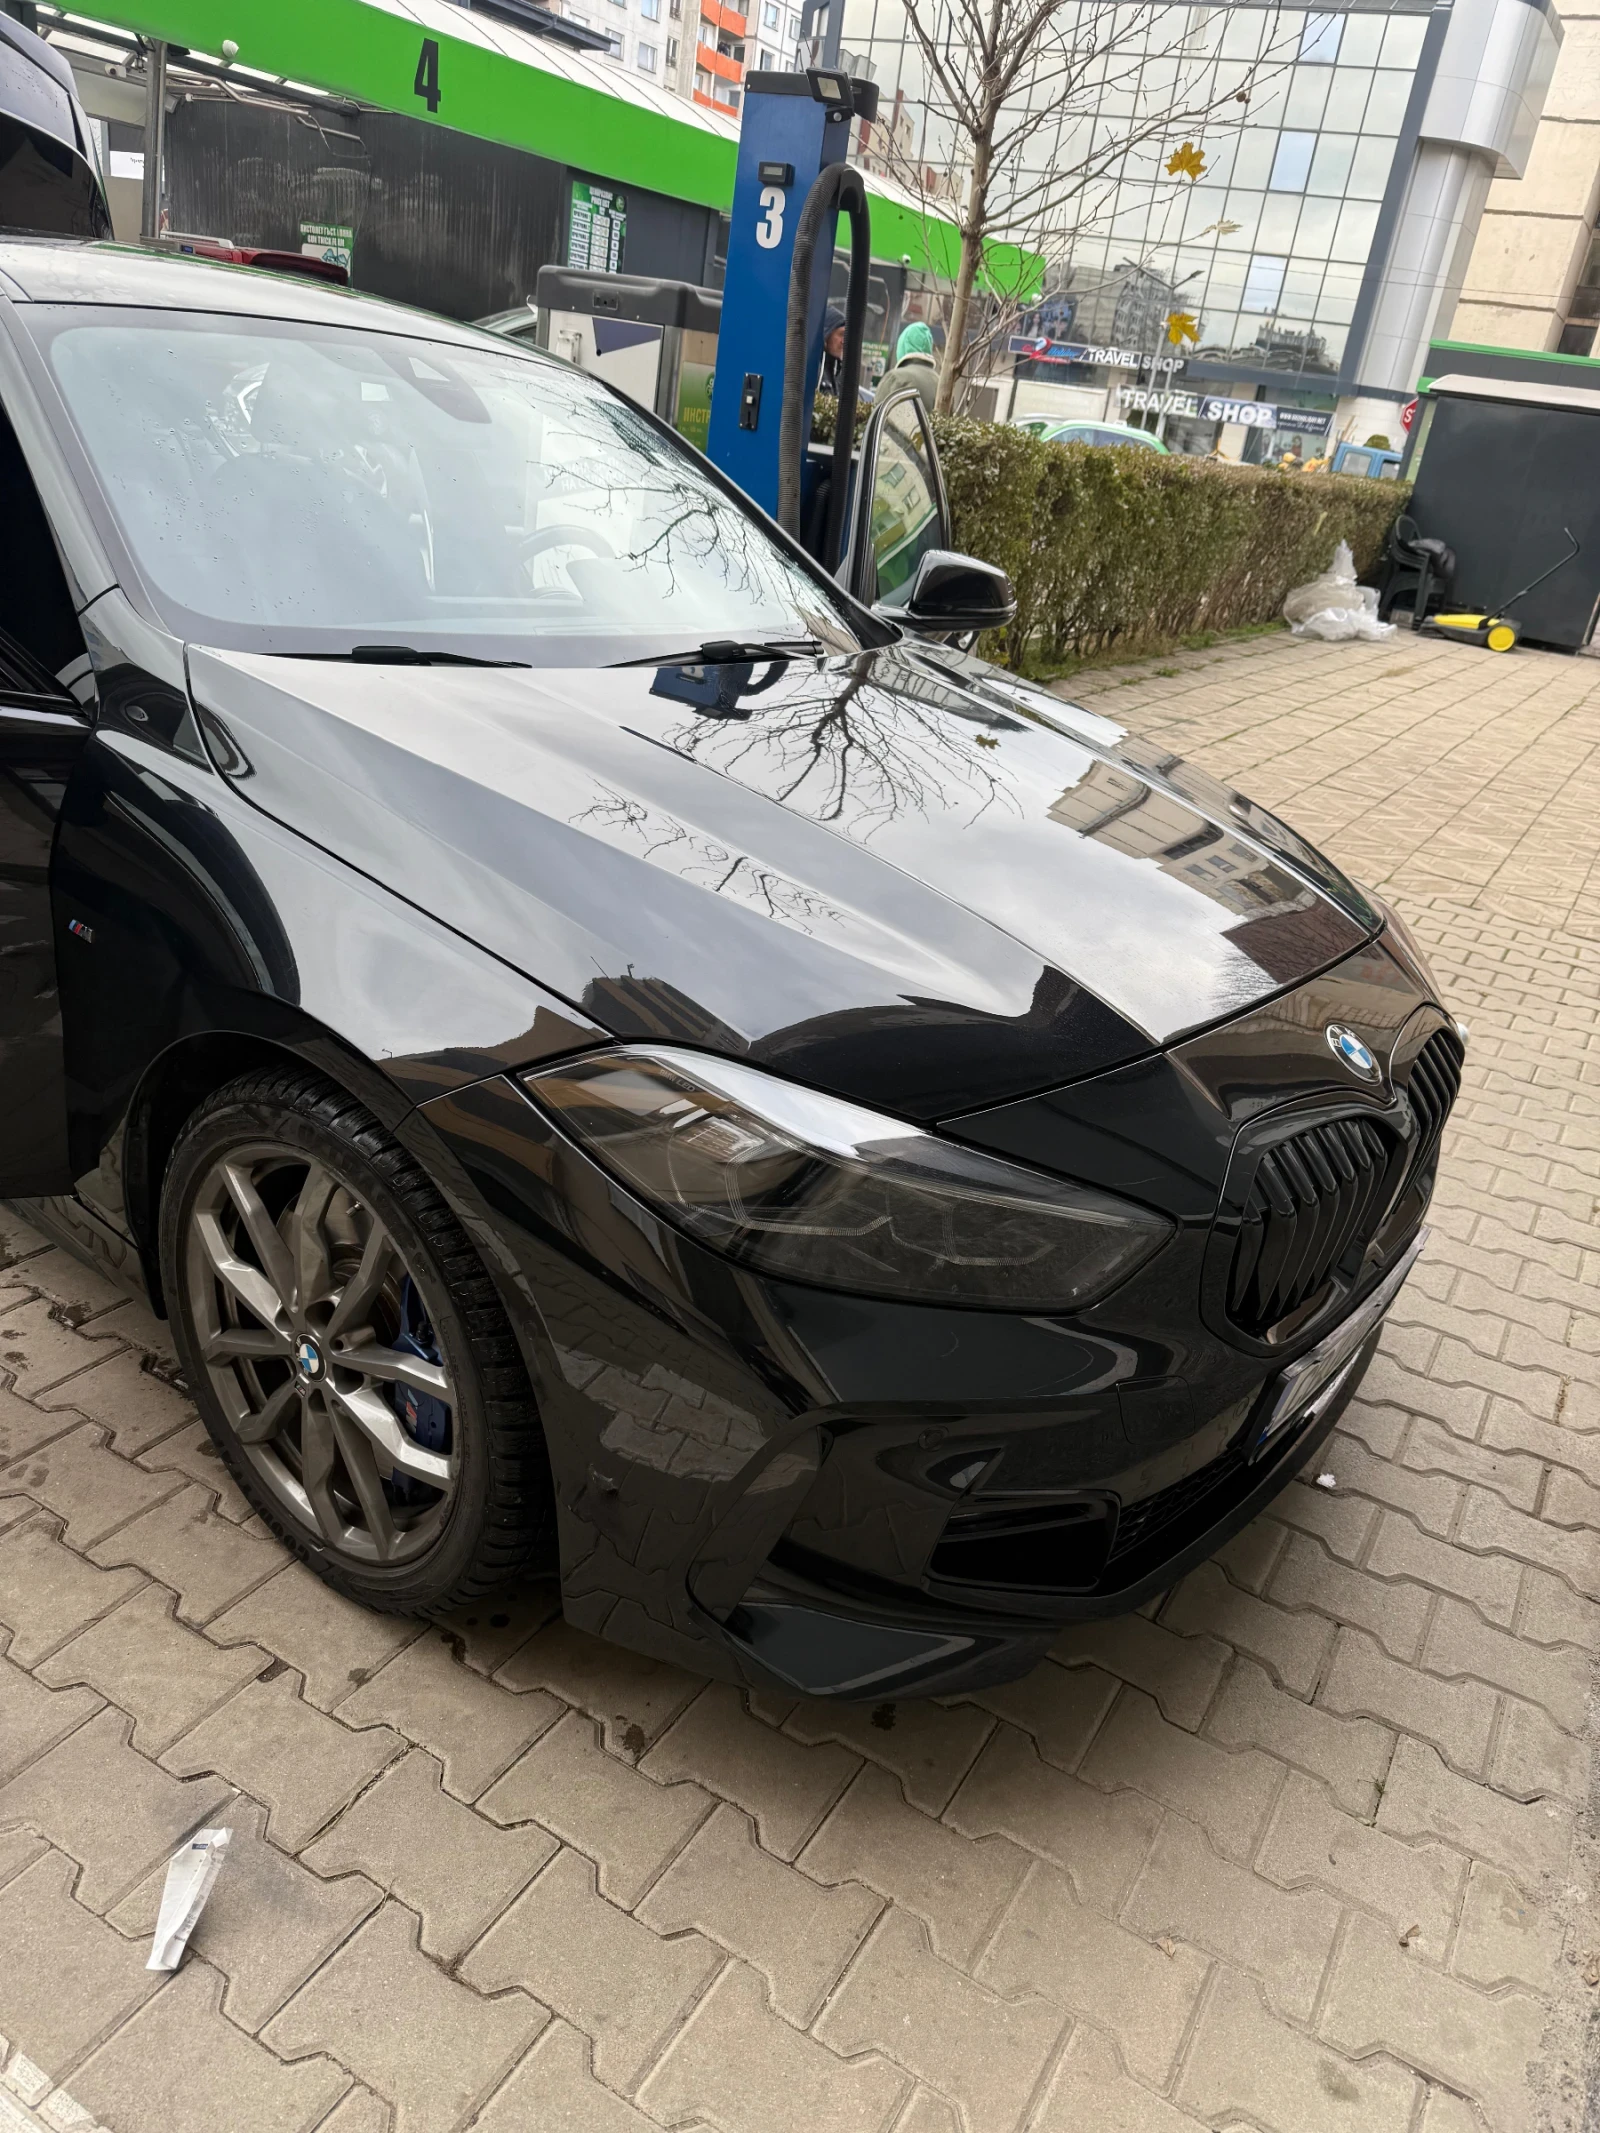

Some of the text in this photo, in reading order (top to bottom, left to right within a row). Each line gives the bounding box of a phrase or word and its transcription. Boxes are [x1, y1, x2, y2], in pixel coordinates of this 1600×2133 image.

[413, 37, 441, 113] 4
[756, 186, 786, 249] 3
[1088, 347, 1138, 368] TRAVEL
[1141, 355, 1184, 373] SHOP
[1123, 389, 1272, 425] TRAVEL SHOP
[1404, 408, 1416, 423] S
[660, 1068, 696, 1092] BMW LED
